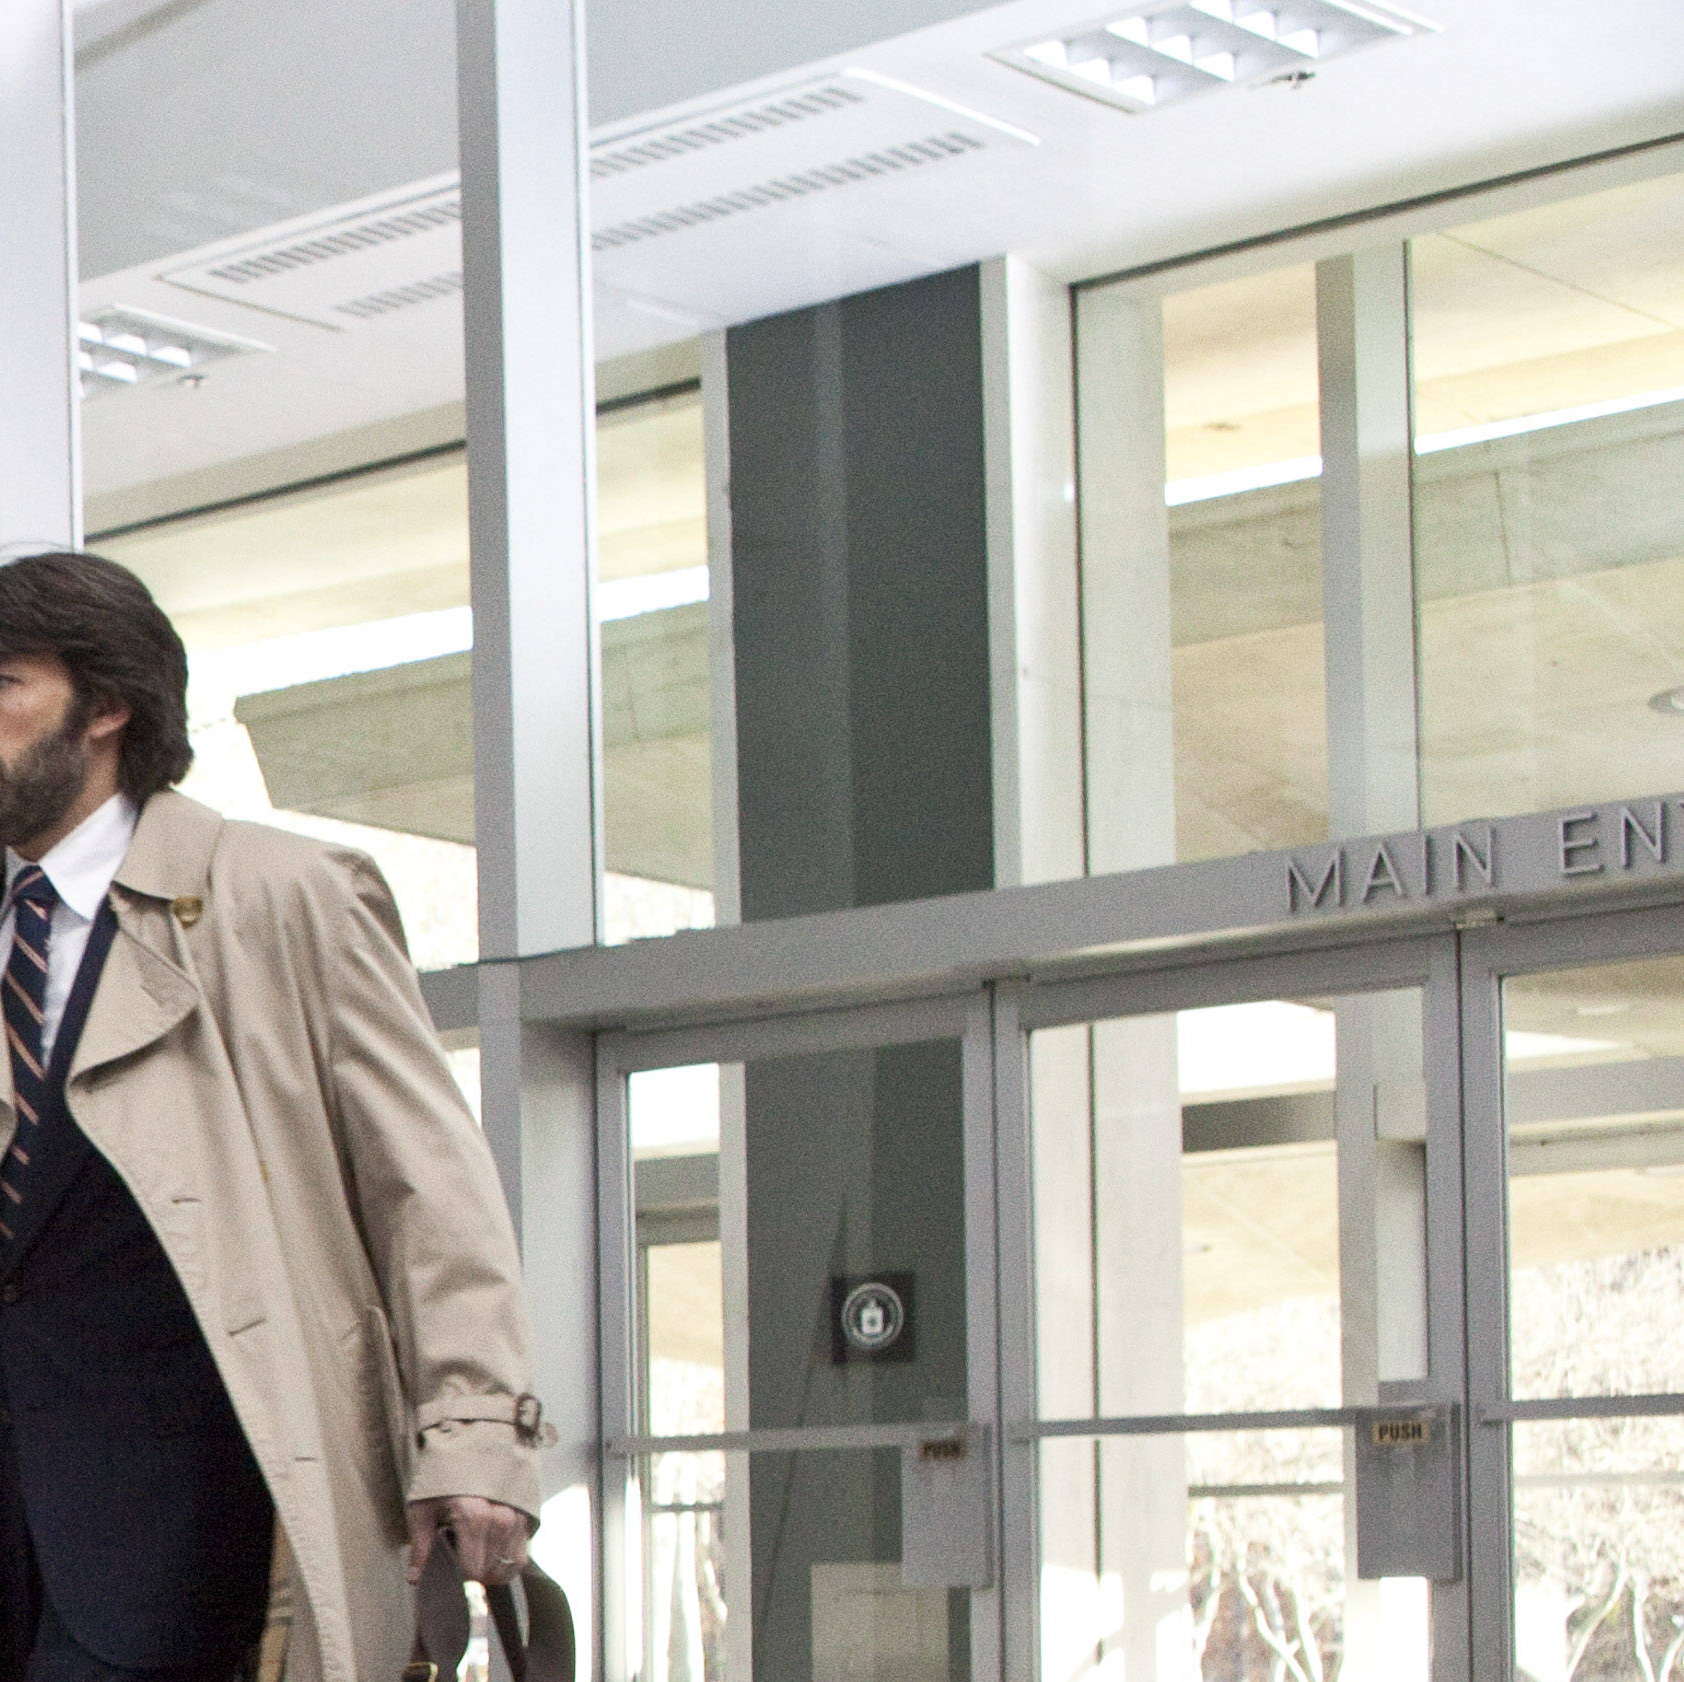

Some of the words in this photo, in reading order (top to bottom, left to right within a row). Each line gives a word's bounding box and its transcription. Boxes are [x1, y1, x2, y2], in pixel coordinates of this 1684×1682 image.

[1286, 824, 1499, 914] MAIN
[1557, 800, 1684, 879] EN
[1378, 1422, 1422, 1441] PUSH
